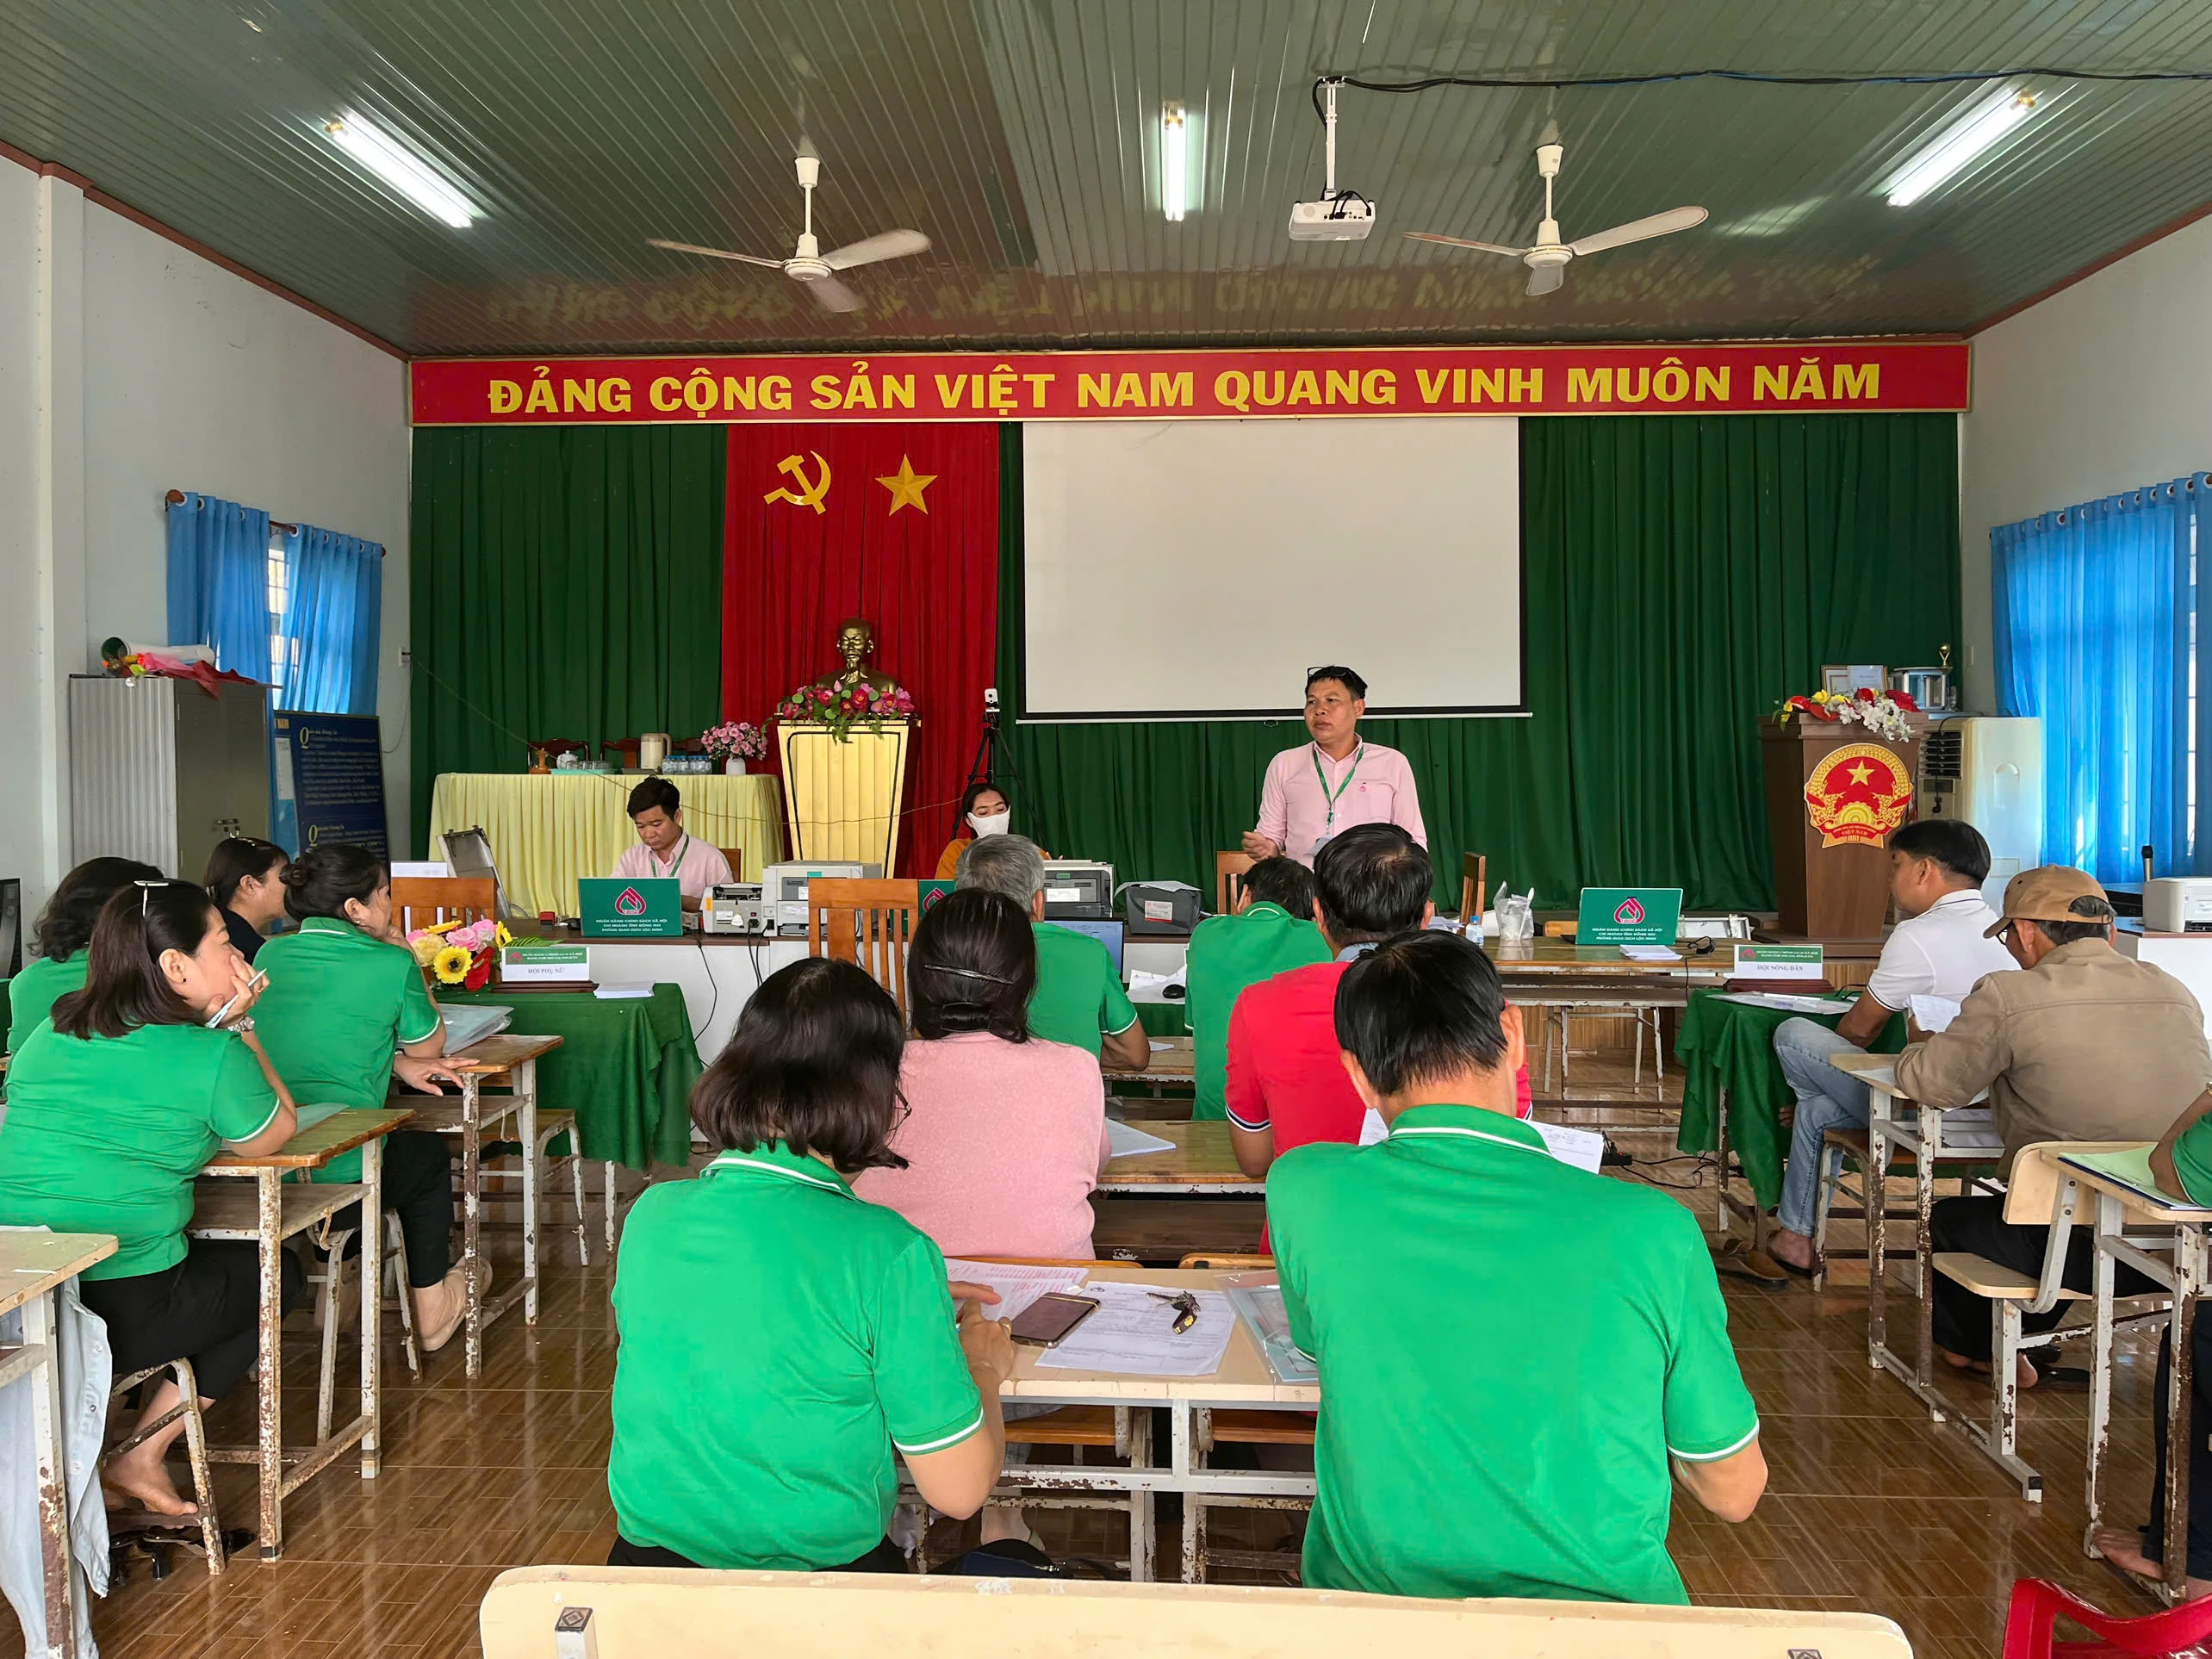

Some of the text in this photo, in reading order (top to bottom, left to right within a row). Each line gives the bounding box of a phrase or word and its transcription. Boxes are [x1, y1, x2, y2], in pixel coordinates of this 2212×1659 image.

[488, 356, 1880, 419] ĐẢNG CỘNG SẢN VIỆT NAM QUANG VINH MUÔN NĂM
